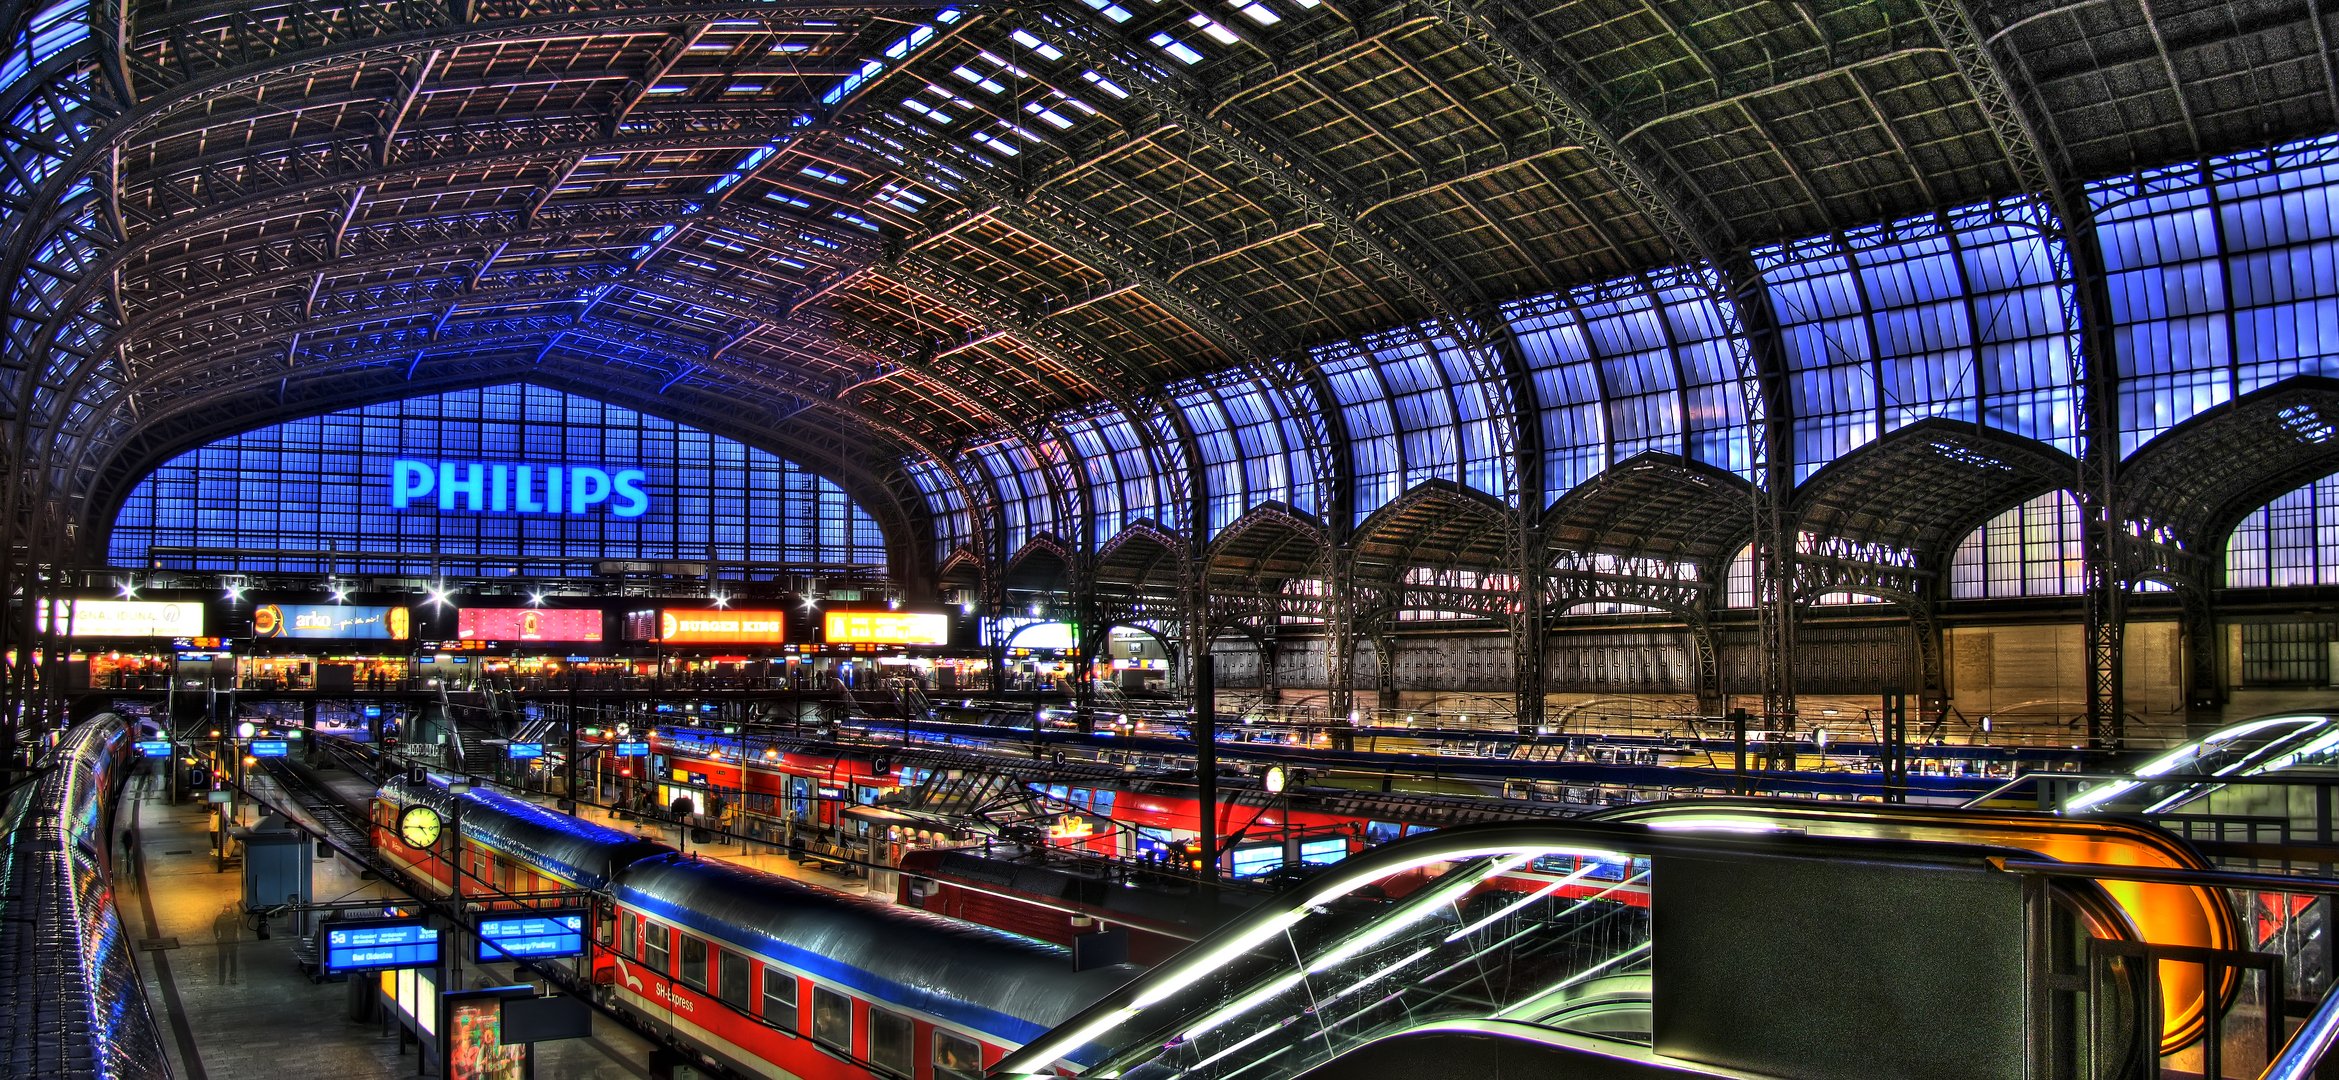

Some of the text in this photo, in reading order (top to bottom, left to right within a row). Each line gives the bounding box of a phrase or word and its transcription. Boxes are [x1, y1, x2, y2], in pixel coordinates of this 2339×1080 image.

[392, 460, 648, 517] PHILIPS
[295, 610, 332, 627] arko
[679, 620, 780, 633] BURGER KING
[875, 758, 887, 773] C
[1057, 751, 1065, 765] C
[192, 769, 204, 786] D
[414, 767, 425, 783] D
[567, 916, 582, 929] 6a
[330, 931, 347, 945] 5a
[638, 923, 643, 939] 2
[352, 952, 394, 962] Bad Oldesloe
[655, 982, 694, 1013] SH-Express
